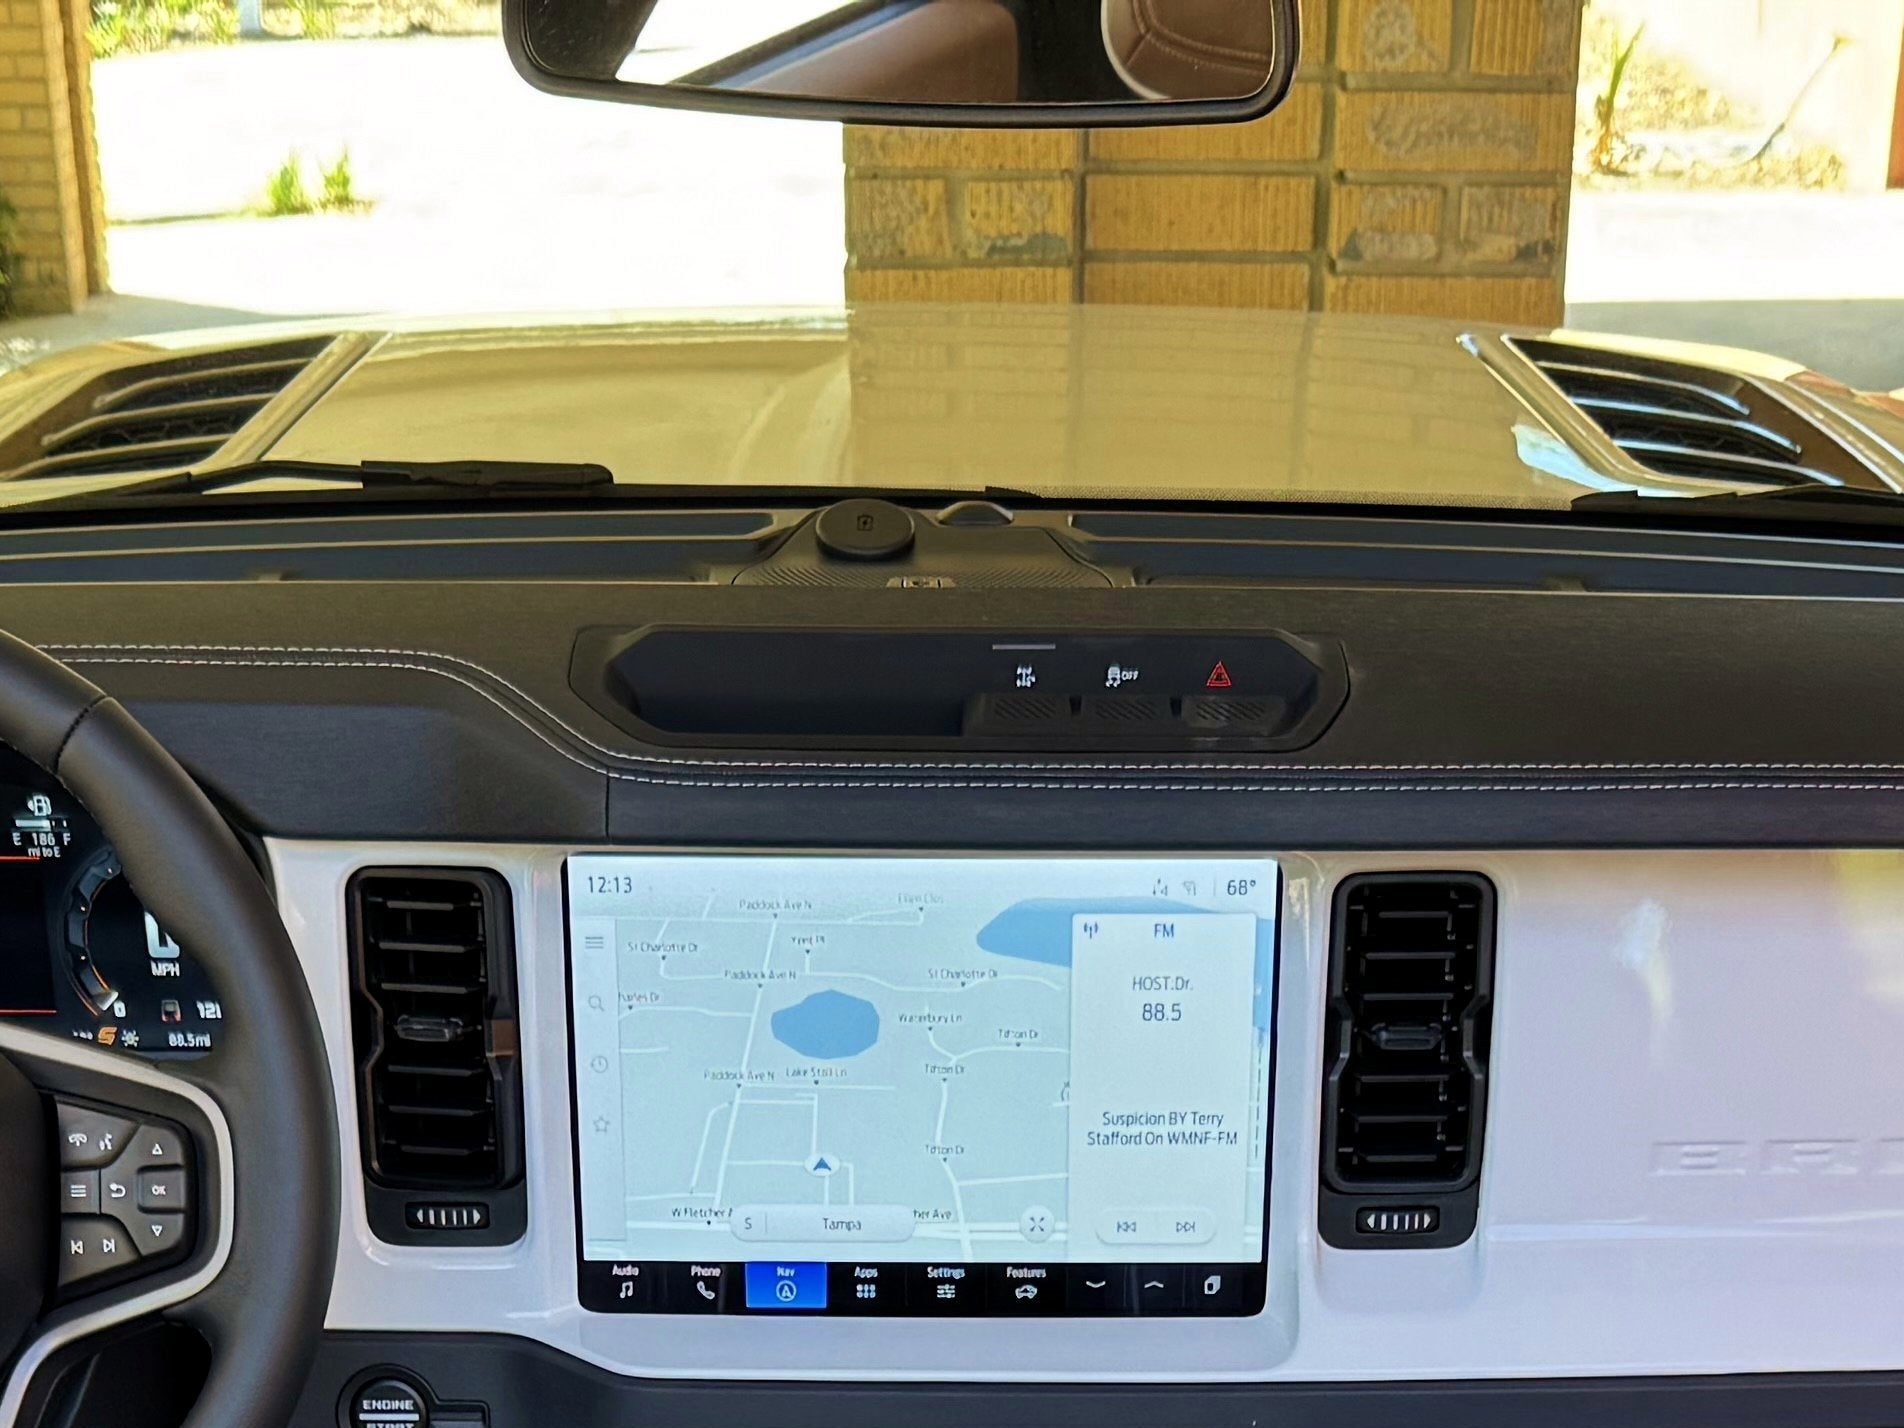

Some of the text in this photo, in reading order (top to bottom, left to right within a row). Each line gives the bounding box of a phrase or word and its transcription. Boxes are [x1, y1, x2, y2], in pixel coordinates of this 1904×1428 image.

[587, 876, 633, 894] 12:13
[1226, 878, 1257, 897] 68°
[1154, 924, 1175, 939] FM
[150, 961, 180, 977] MPH
[1142, 1003, 1182, 1022] 88.5
[1102, 1111, 1224, 1129] Suspicion BY Terry
[1087, 1131, 1238, 1146] Stafford On WMNF-FM
[151, 1184, 166, 1196] OK
[744, 1217, 753, 1230] S
[823, 1217, 862, 1232] Tampa
[612, 1264, 640, 1277] Audio
[690, 1264, 721, 1277] Phone
[776, 1265, 795, 1277] Nav
[854, 1265, 878, 1280] Apps
[927, 1265, 966, 1280] Settings
[1006, 1265, 1047, 1278] Features
[362, 1400, 414, 1411] ENGINE
